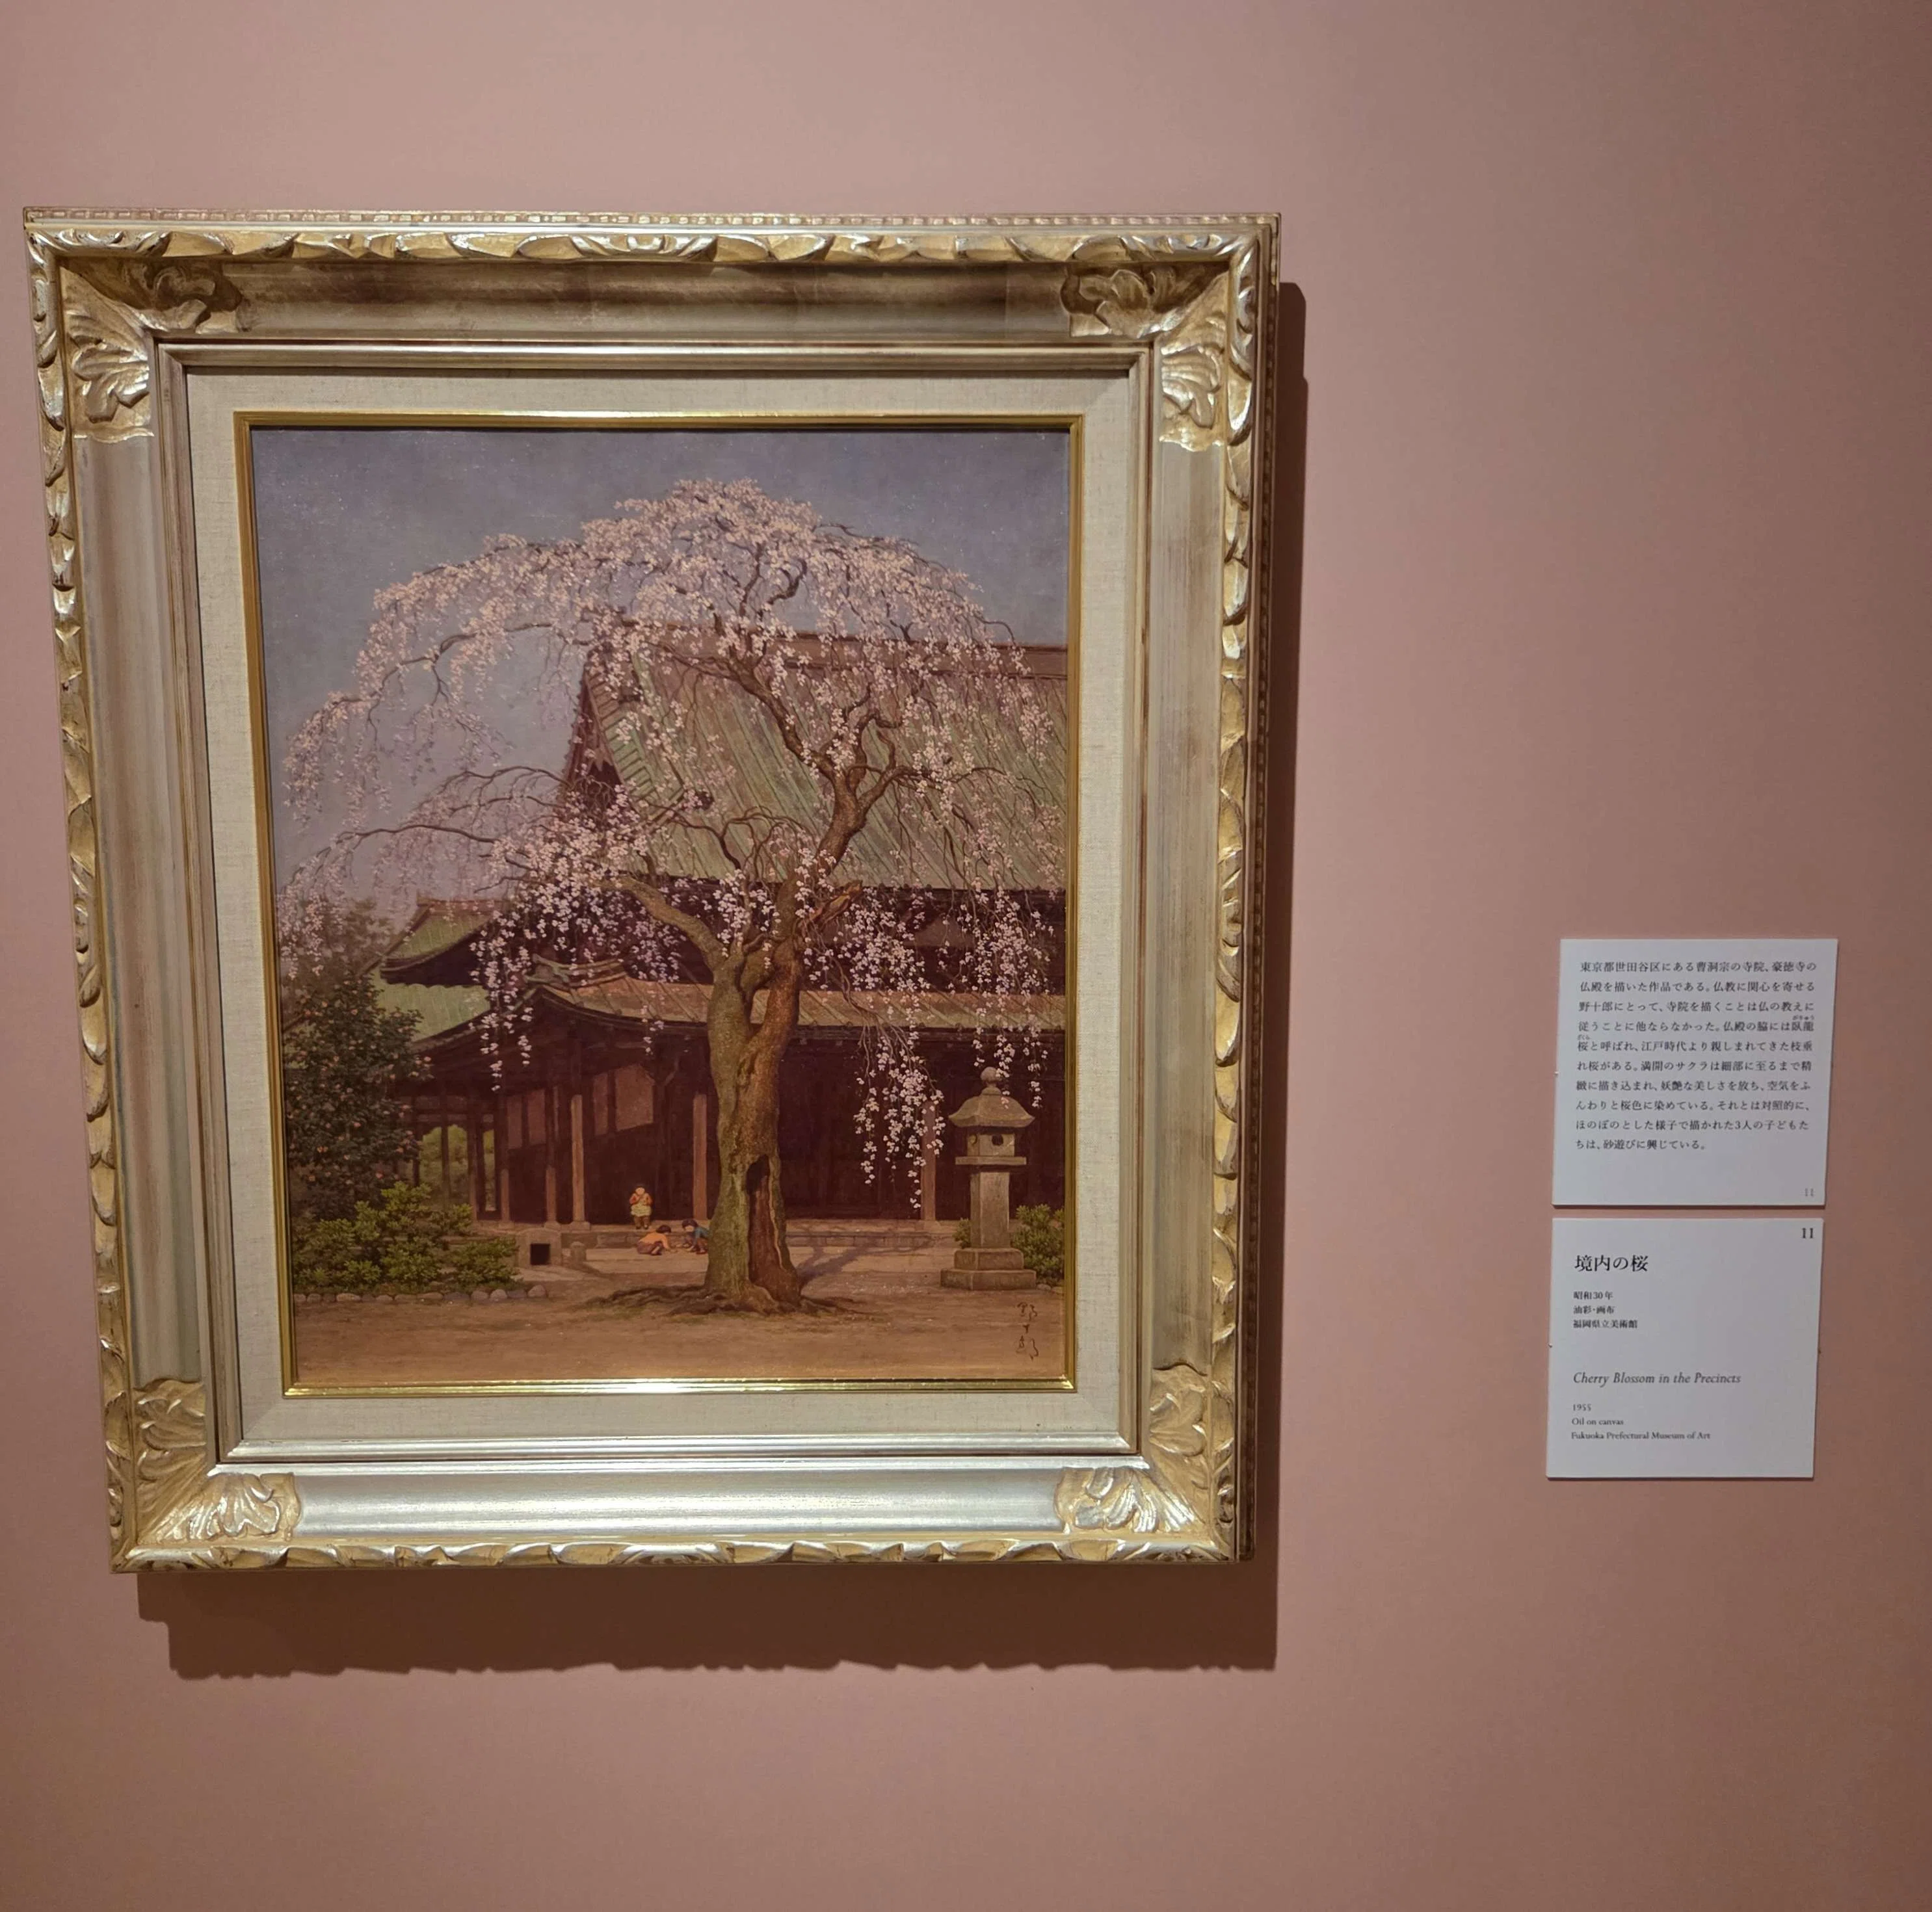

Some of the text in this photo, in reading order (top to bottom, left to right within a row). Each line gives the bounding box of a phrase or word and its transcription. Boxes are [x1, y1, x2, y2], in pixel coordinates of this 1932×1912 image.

[1576, 1139, 1705, 1150] ちは、砂遊びに興じている。
[1801, 1227, 1814, 1239] 11
[1574, 1255, 1648, 1272] 境内の桜
[1572, 1319, 1637, 1329] 福岡県立美術館
[1573, 1372, 1741, 1388] Cherry Blossom in the Precincts
